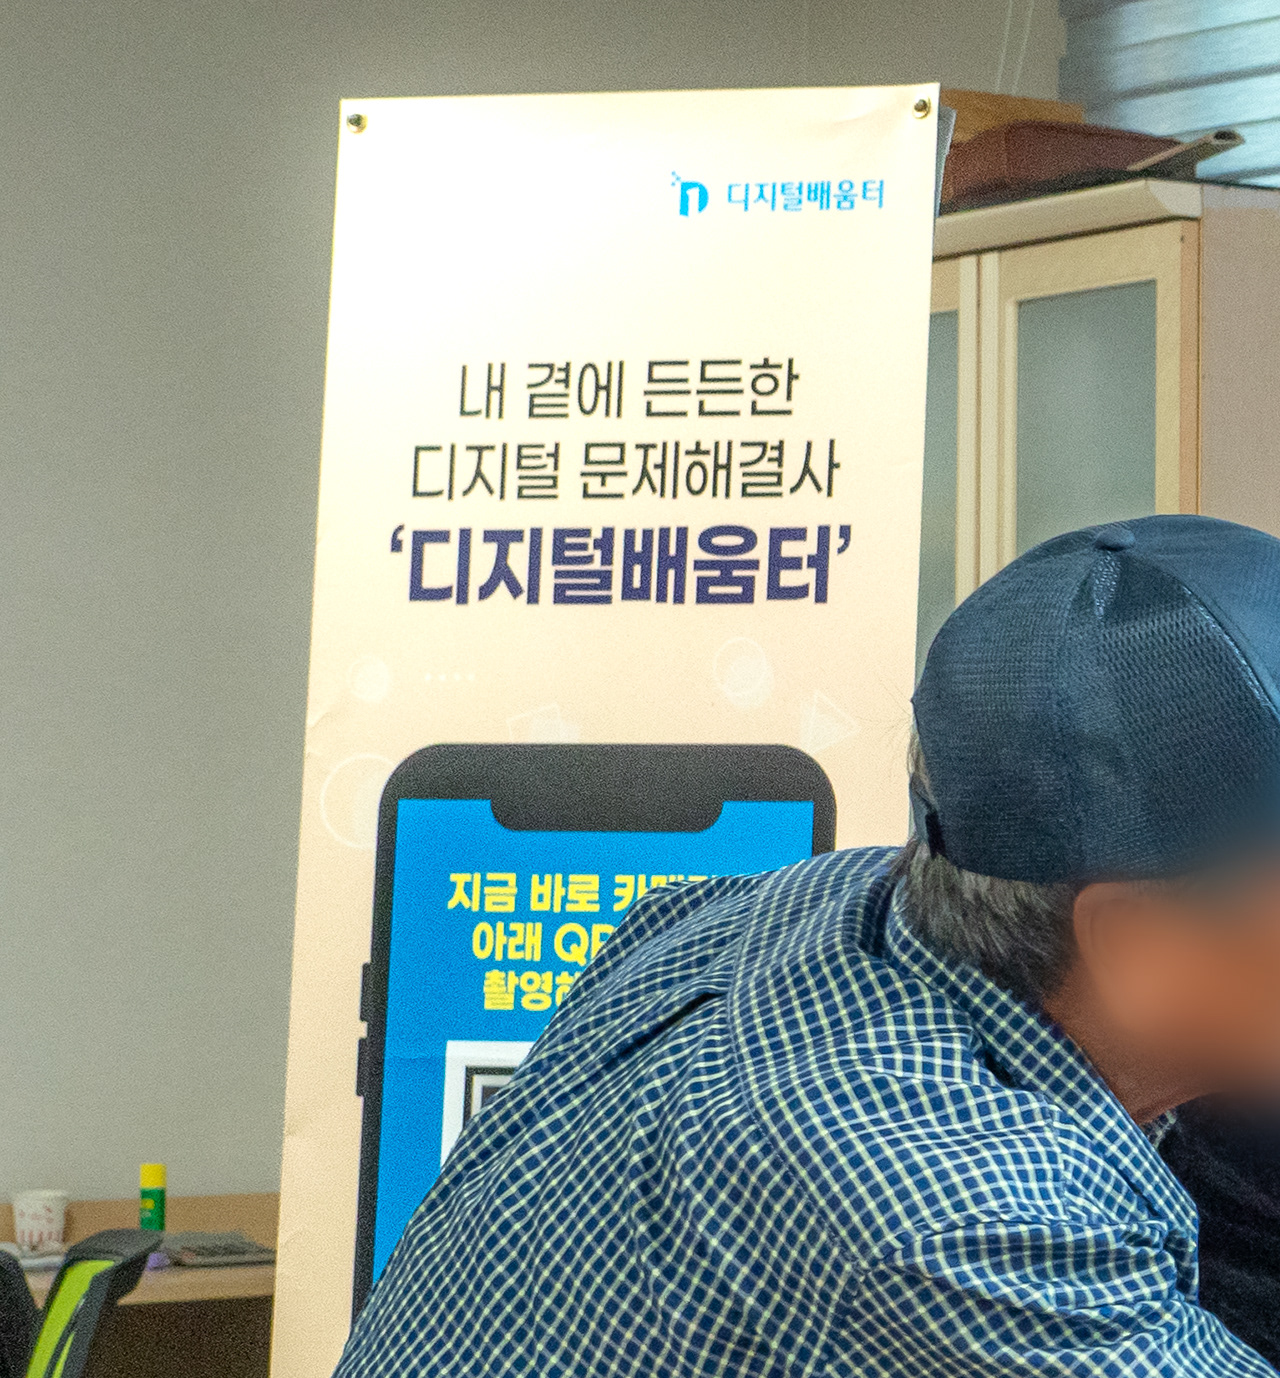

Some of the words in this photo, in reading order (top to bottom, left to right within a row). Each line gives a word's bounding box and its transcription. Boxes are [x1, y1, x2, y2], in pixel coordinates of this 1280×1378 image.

[728, 179, 884, 212] 디지털배움터
[459, 361, 506, 419] 내
[527, 359, 626, 419] 곁에
[643, 357, 800, 417] 든든한
[411, 441, 561, 501] 디지털
[580, 438, 841, 500] 문제해결사
[447, 872, 517, 913] 지금
[530, 873, 600, 913] 바로
[472, 921, 542, 961] 아래
